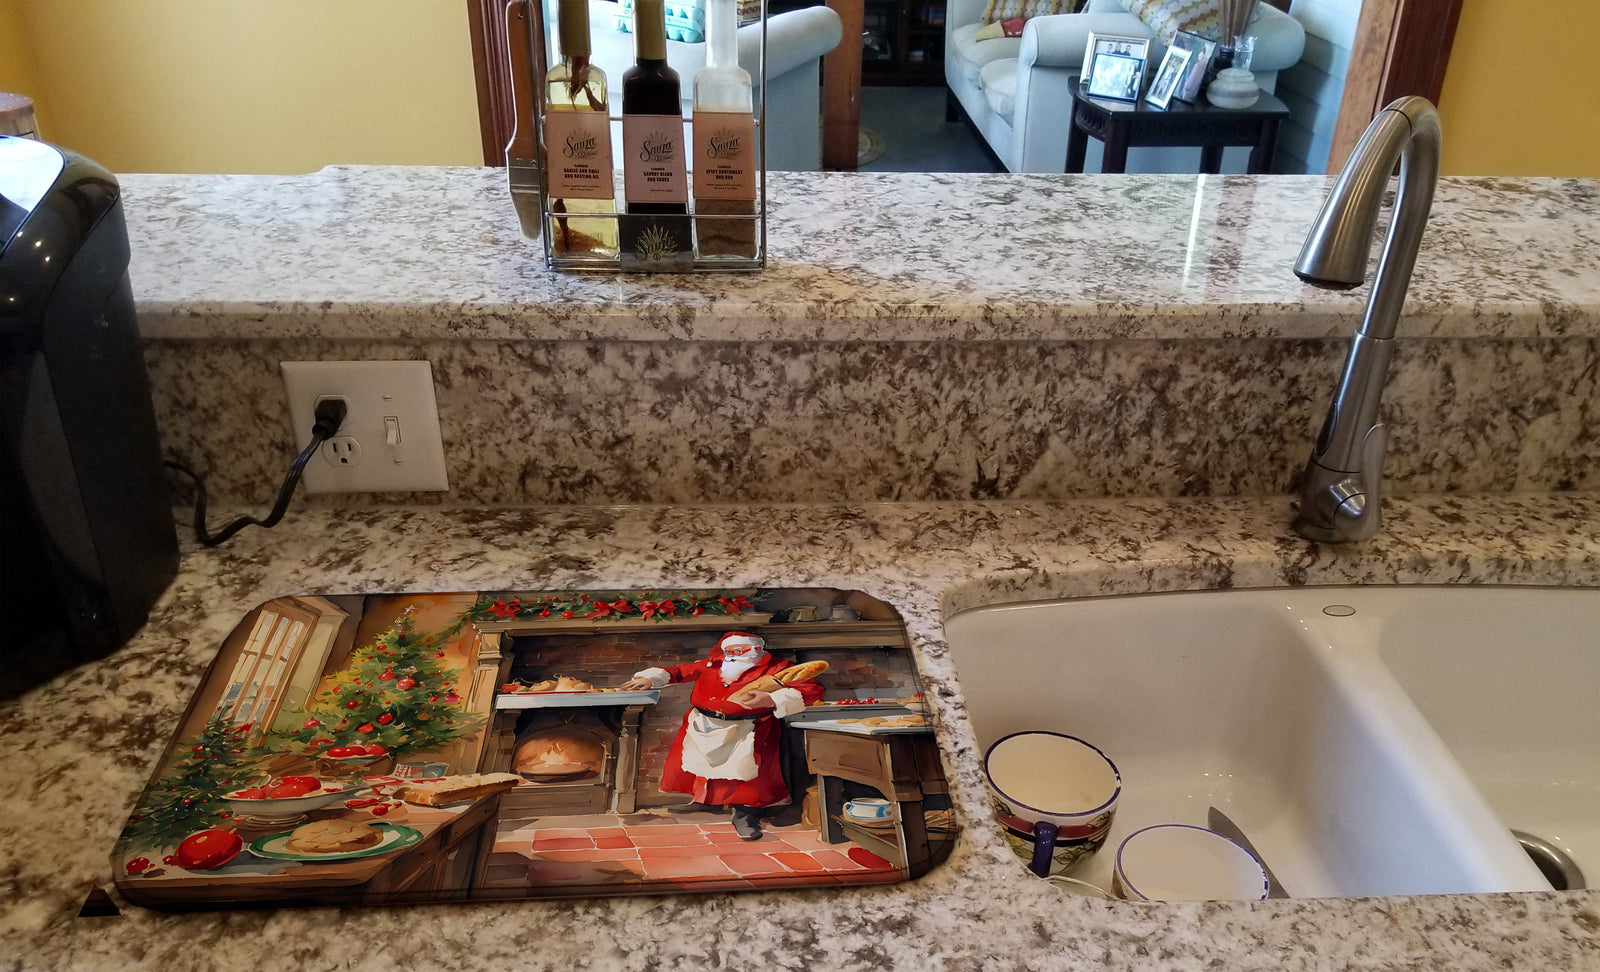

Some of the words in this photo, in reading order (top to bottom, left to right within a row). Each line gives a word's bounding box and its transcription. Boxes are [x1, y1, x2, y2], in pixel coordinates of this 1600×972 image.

[563, 136, 598, 158] Sauza
[640, 140, 674, 161] Sauza
[707, 136, 741, 158] Sauza
